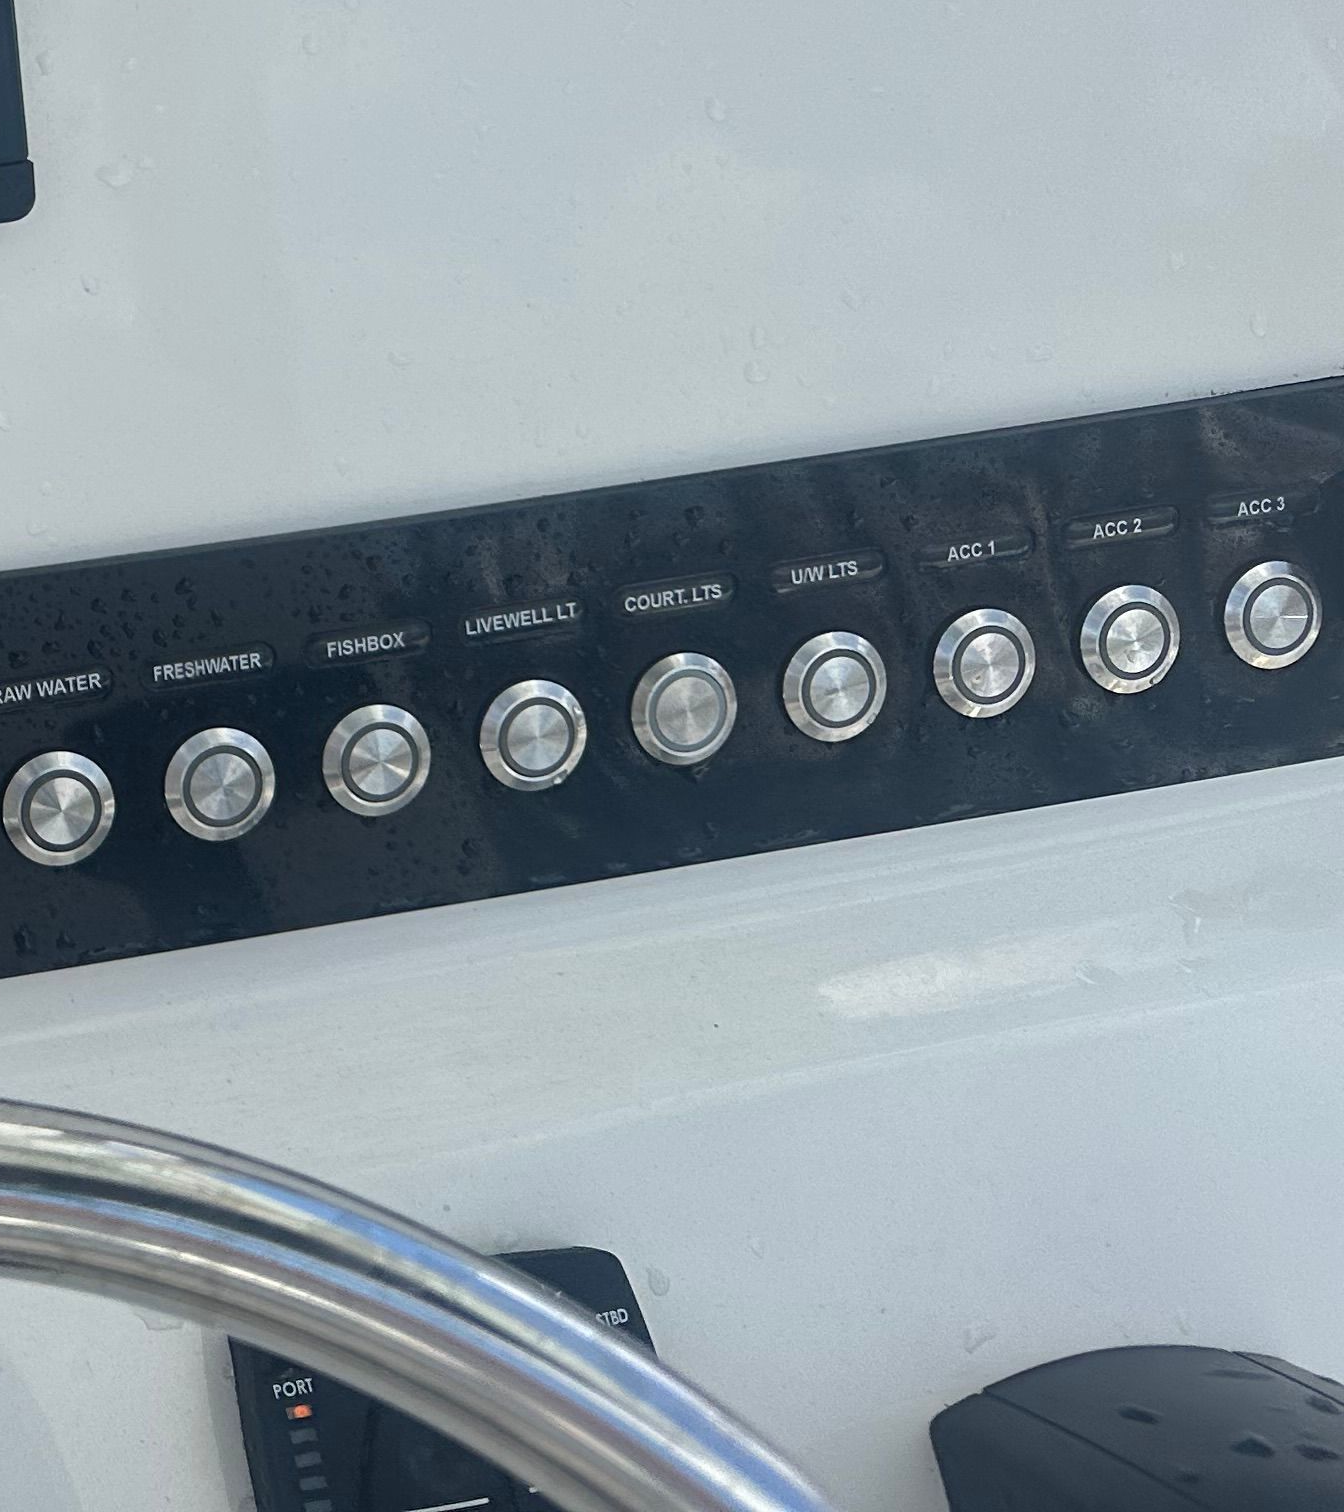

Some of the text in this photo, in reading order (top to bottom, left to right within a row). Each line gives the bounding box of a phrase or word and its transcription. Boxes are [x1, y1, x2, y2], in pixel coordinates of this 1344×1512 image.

[1237, 496, 1286, 518] ACC 3
[1092, 518, 1143, 541] ACC 2
[947, 540, 996, 563] ACC 1
[791, 560, 859, 586] U/W LTS
[624, 583, 723, 613] COURT. LTS
[464, 602, 577, 636] LIVEWELL LT
[326, 631, 406, 658] FISHBOX
[153, 652, 262, 683] FRESHWATER
[36, 672, 103, 698] WATER
[595, 1308, 628, 1326] STBD
[272, 1377, 312, 1399] PORT
